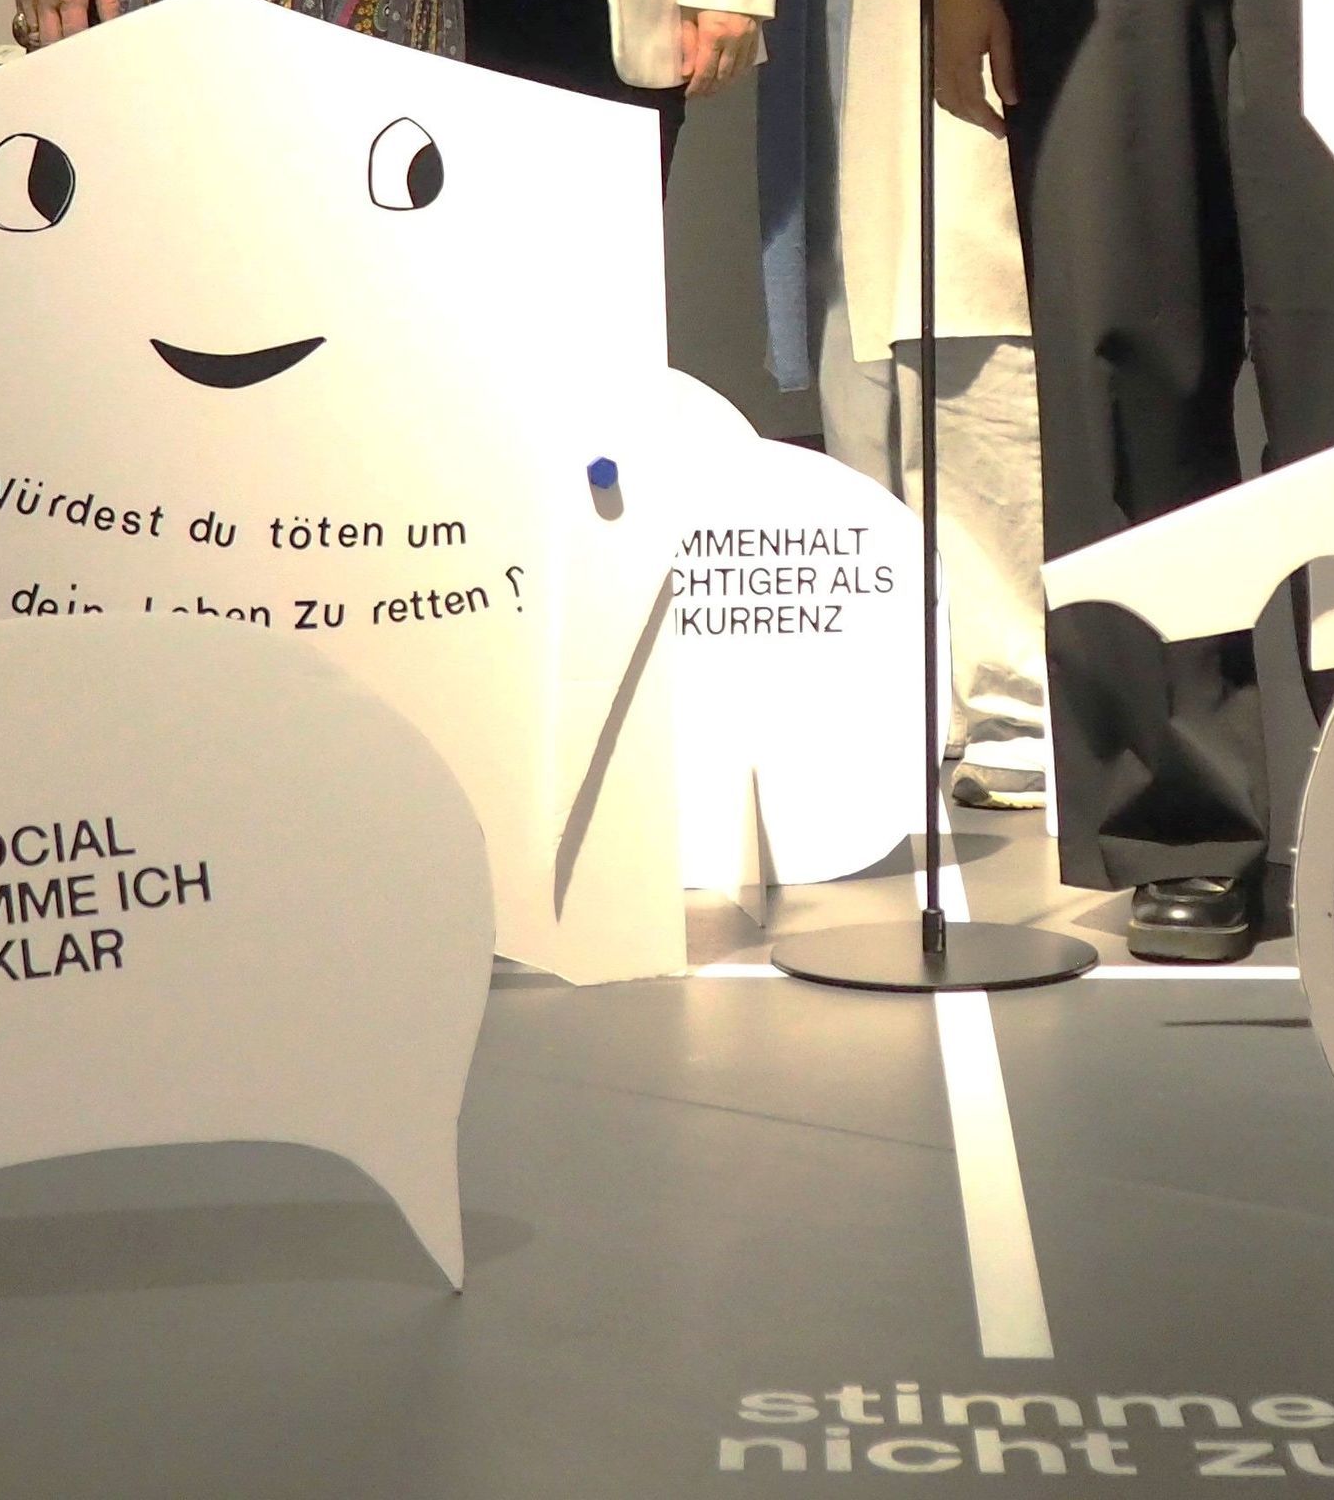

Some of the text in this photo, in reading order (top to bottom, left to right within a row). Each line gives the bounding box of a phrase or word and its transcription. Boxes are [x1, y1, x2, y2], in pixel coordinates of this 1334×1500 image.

[188, 510, 237, 549] du
[269, 515, 384, 551] töten
[407, 520, 467, 548] um
[674, 527, 870, 558] MMENHALT
[829, 565, 894, 595] ALS
[372, 586, 490, 626] retten
[674, 604, 843, 636] KURRENZ
[117, 860, 213, 912] ICH
[719, 1426, 1138, 1476] nicht
